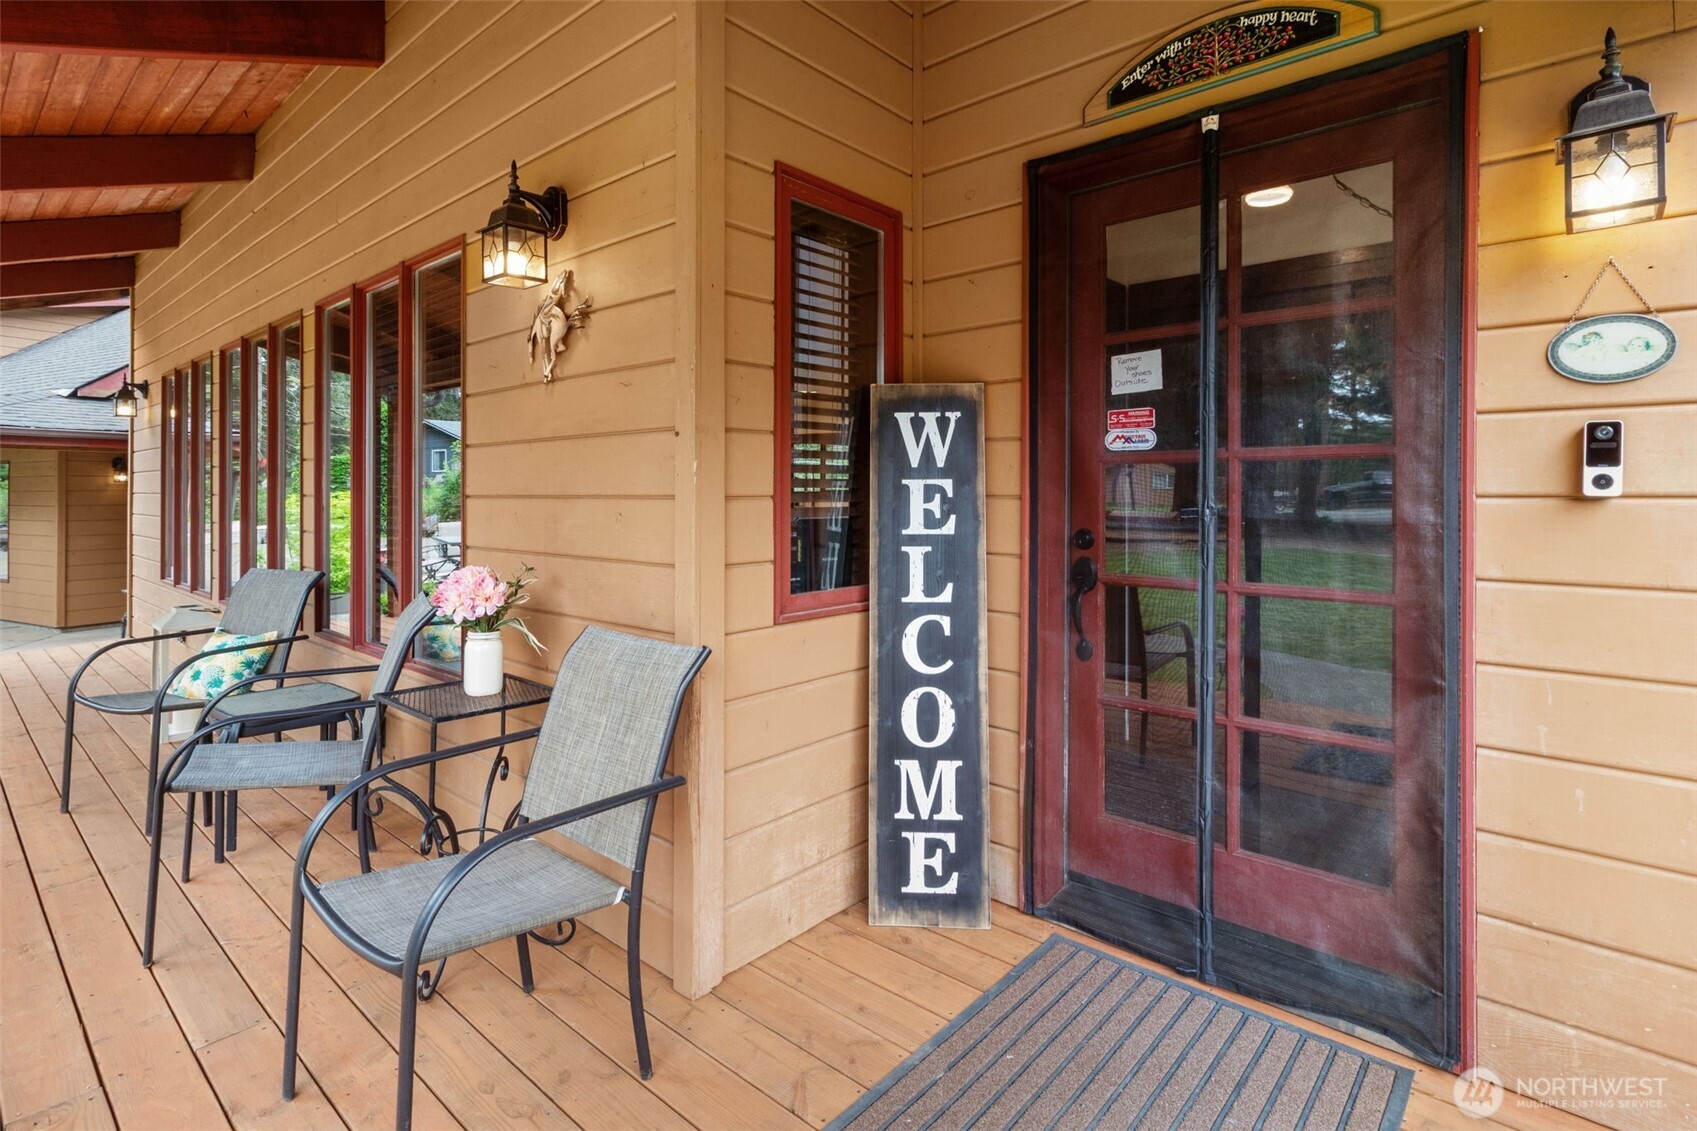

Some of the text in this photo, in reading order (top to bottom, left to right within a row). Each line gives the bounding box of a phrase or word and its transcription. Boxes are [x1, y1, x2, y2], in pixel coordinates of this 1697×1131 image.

[1121, 9, 1318, 91] Enter with a happy heart
[1114, 378, 1148, 388] Outside
[1115, 356, 1142, 366] Remove
[893, 410, 963, 896] WELCOME
